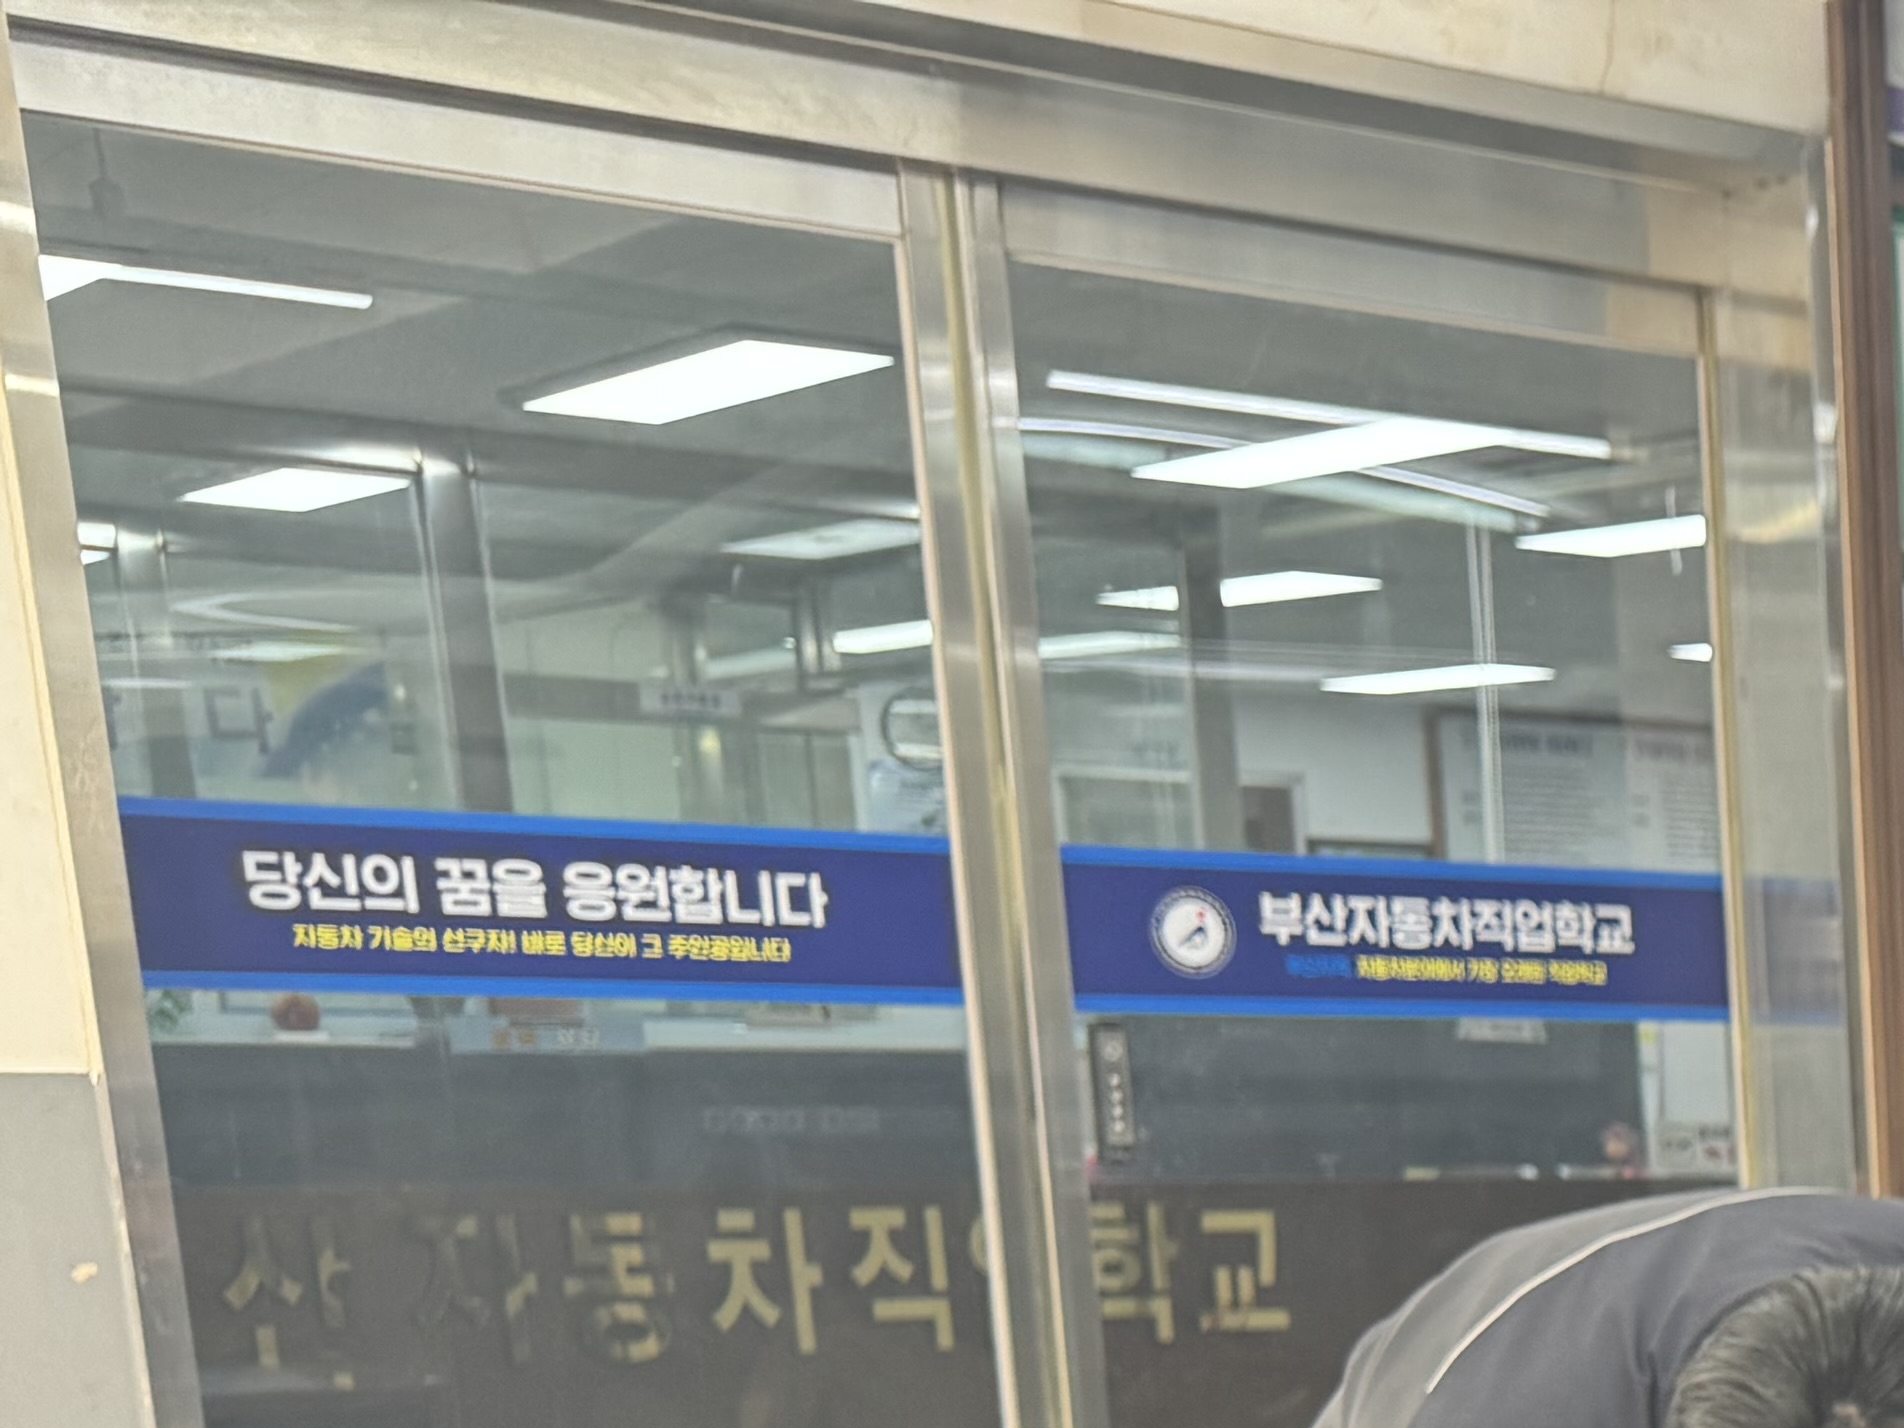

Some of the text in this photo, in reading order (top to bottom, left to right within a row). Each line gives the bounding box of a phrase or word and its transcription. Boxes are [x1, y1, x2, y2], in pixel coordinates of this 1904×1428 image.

[241, 849, 830, 929] 당신의 꿈을 응원합니다
[292, 922, 364, 950] 자동차
[367, 925, 438, 952] 기술의
[521, 930, 567, 956] 바로
[570, 930, 638, 958] 당신이
[641, 933, 664, 959] 그
[668, 934, 792, 963] 주인공입니다
[1258, 891, 1636, 955] 부산자동차직업학교
